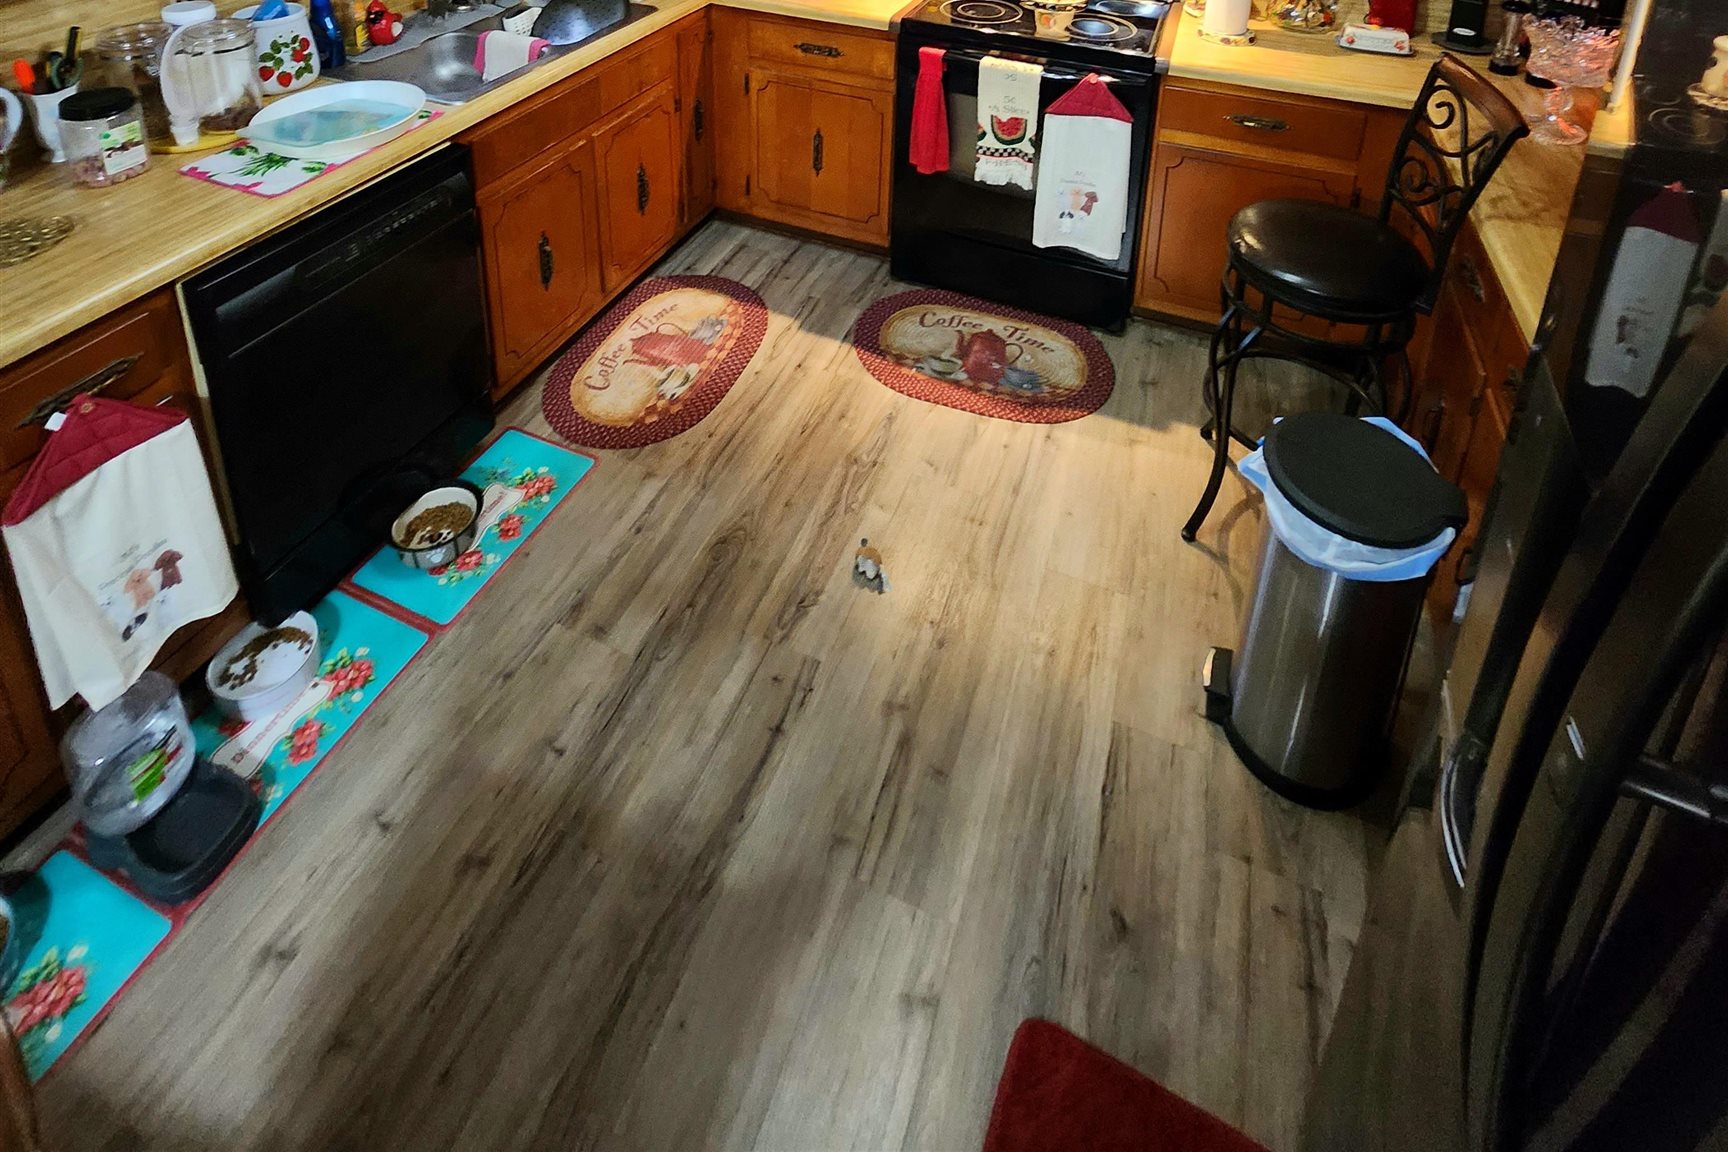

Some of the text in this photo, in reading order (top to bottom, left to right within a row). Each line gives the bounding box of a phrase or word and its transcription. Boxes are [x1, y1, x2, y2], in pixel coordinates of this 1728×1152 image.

[583, 303, 679, 391] Coffee Time
[919, 311, 1055, 353] Coffee Time
